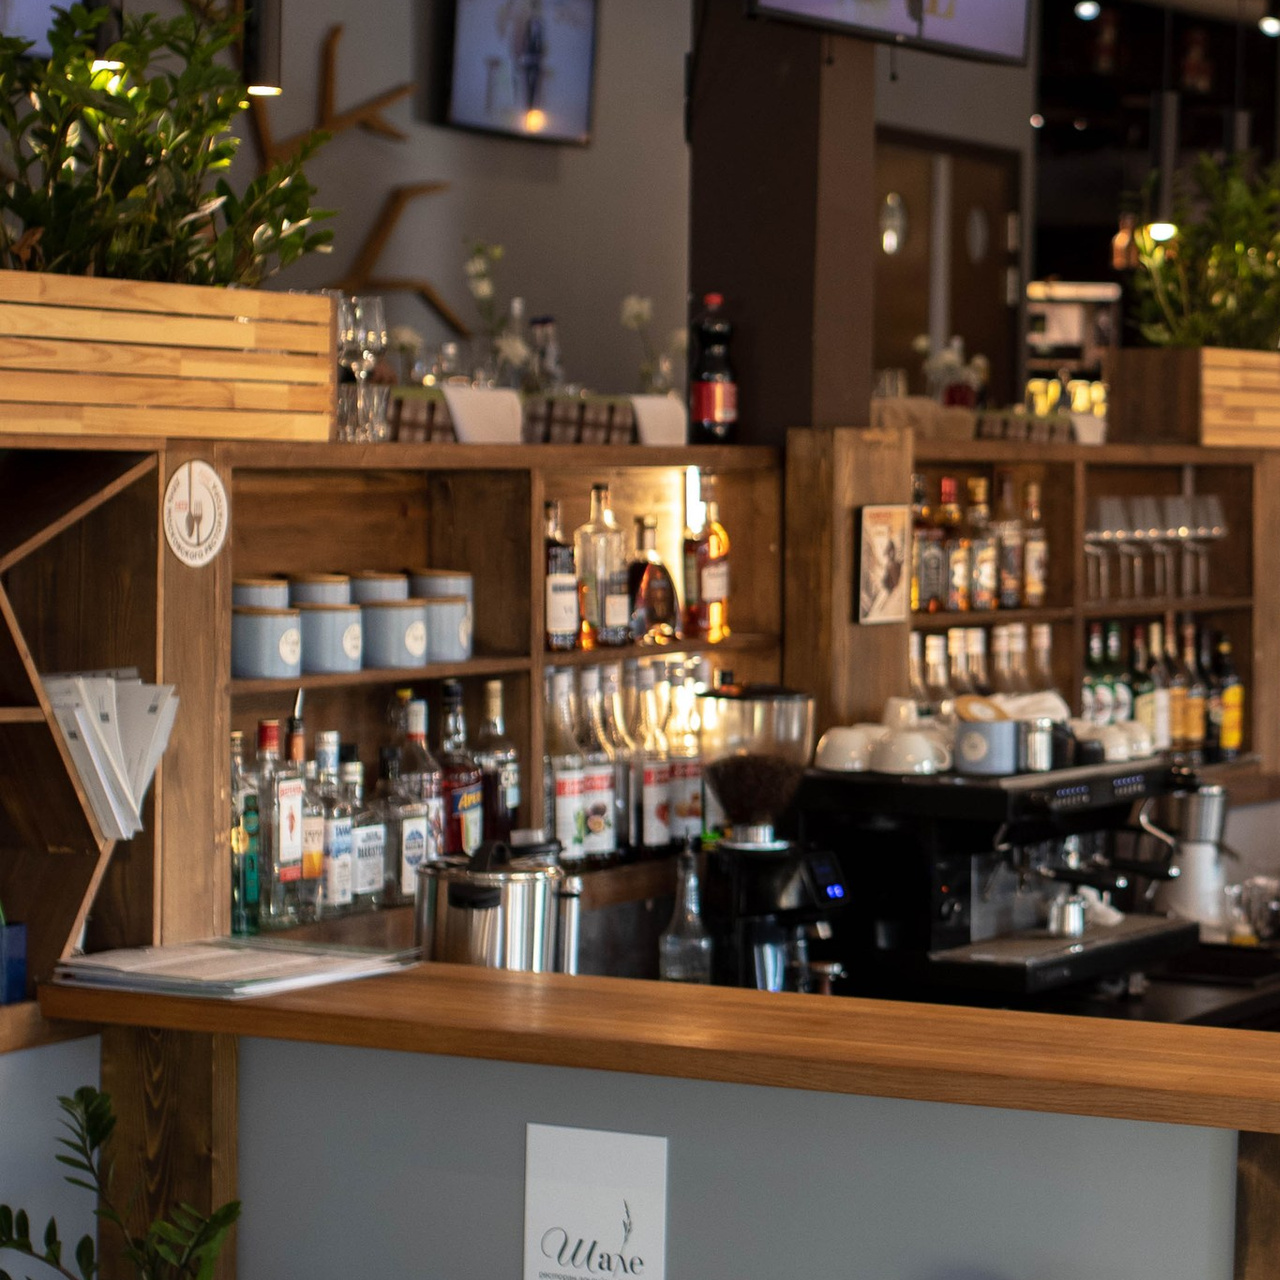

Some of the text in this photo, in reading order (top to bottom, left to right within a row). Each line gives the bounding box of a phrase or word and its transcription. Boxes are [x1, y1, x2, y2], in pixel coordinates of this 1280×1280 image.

[166, 507, 204, 560] МОСКОВСКОГО
[204, 482, 223, 556] РЕСТОРАТОРА
[540, 1226, 645, 1276] Шале
